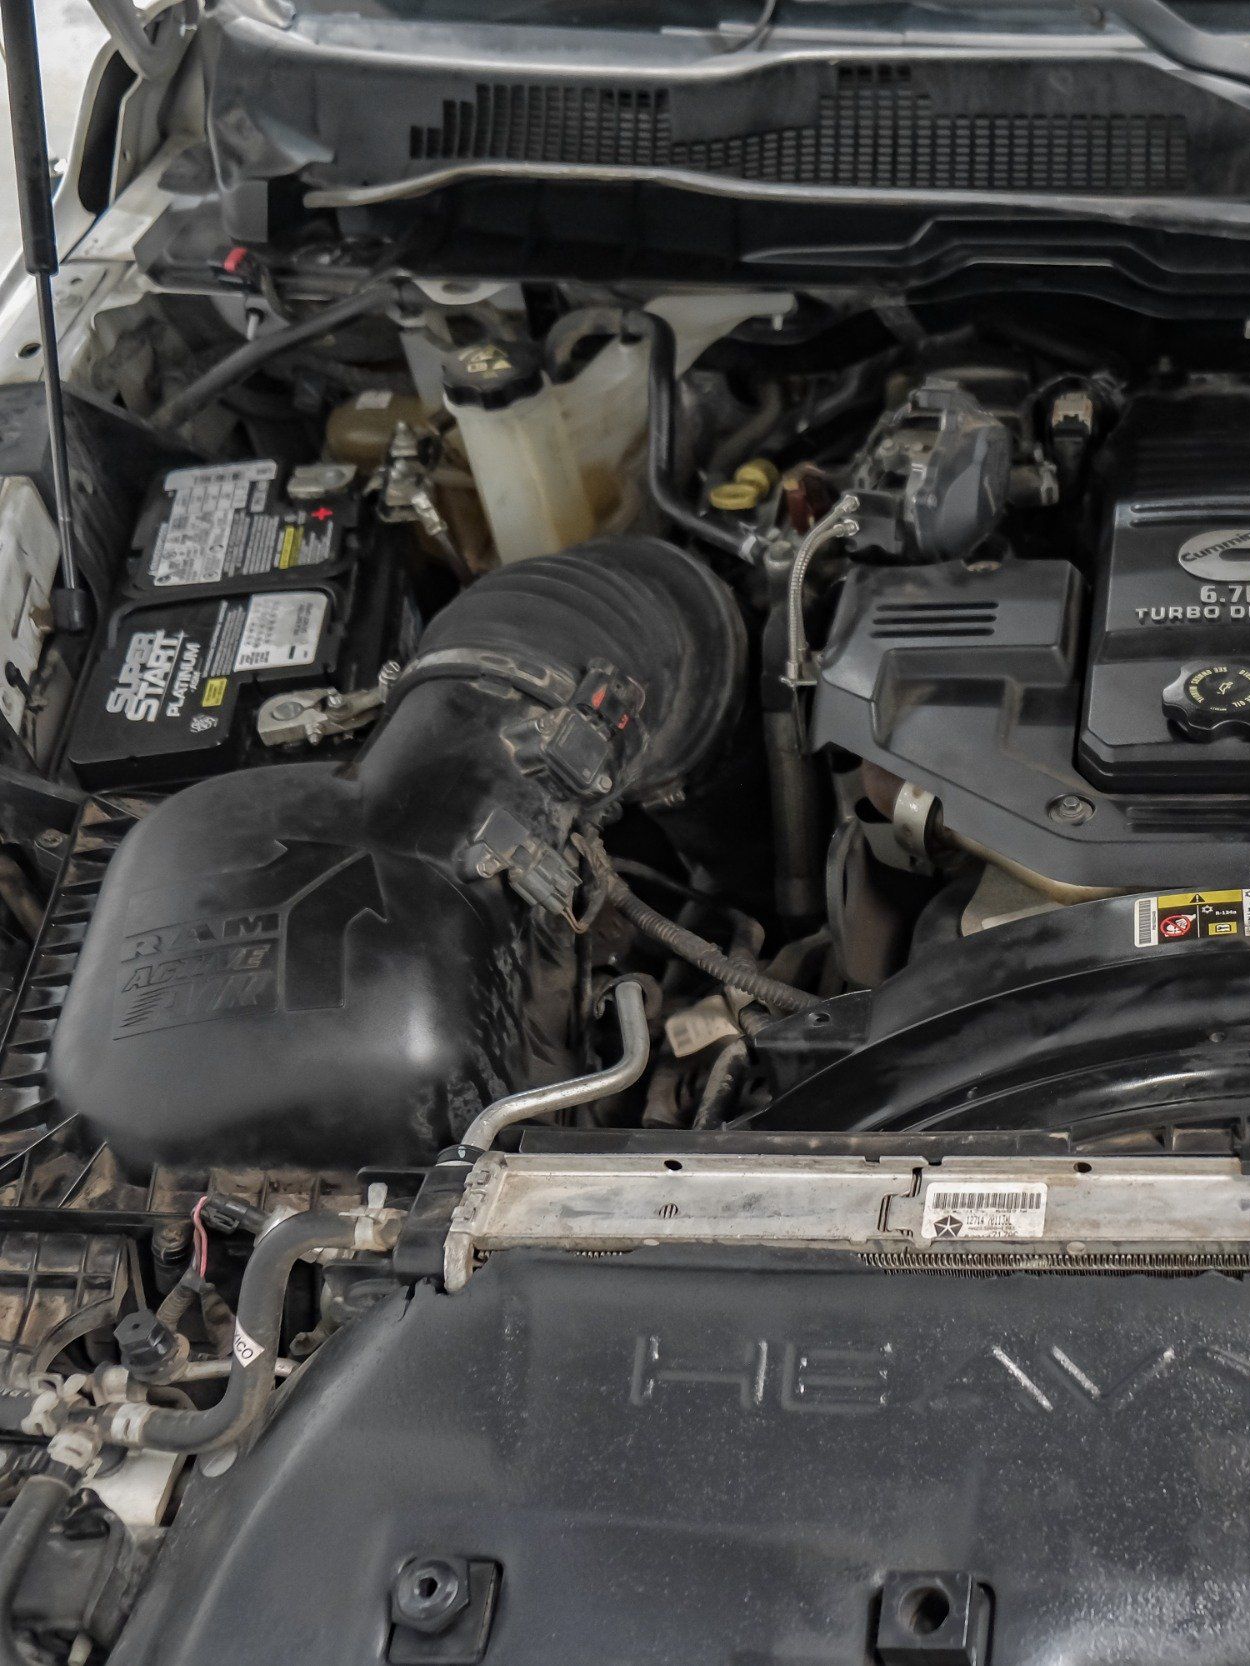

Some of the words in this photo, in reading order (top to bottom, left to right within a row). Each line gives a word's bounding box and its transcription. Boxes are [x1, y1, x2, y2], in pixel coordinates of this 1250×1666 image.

[1135, 606, 1220, 620] TURBO
[106, 632, 157, 714] SUPER
[125, 629, 179, 722] START
[166, 642, 201, 717] PLATINUM
[1232, 700, 1246, 708] OIL
